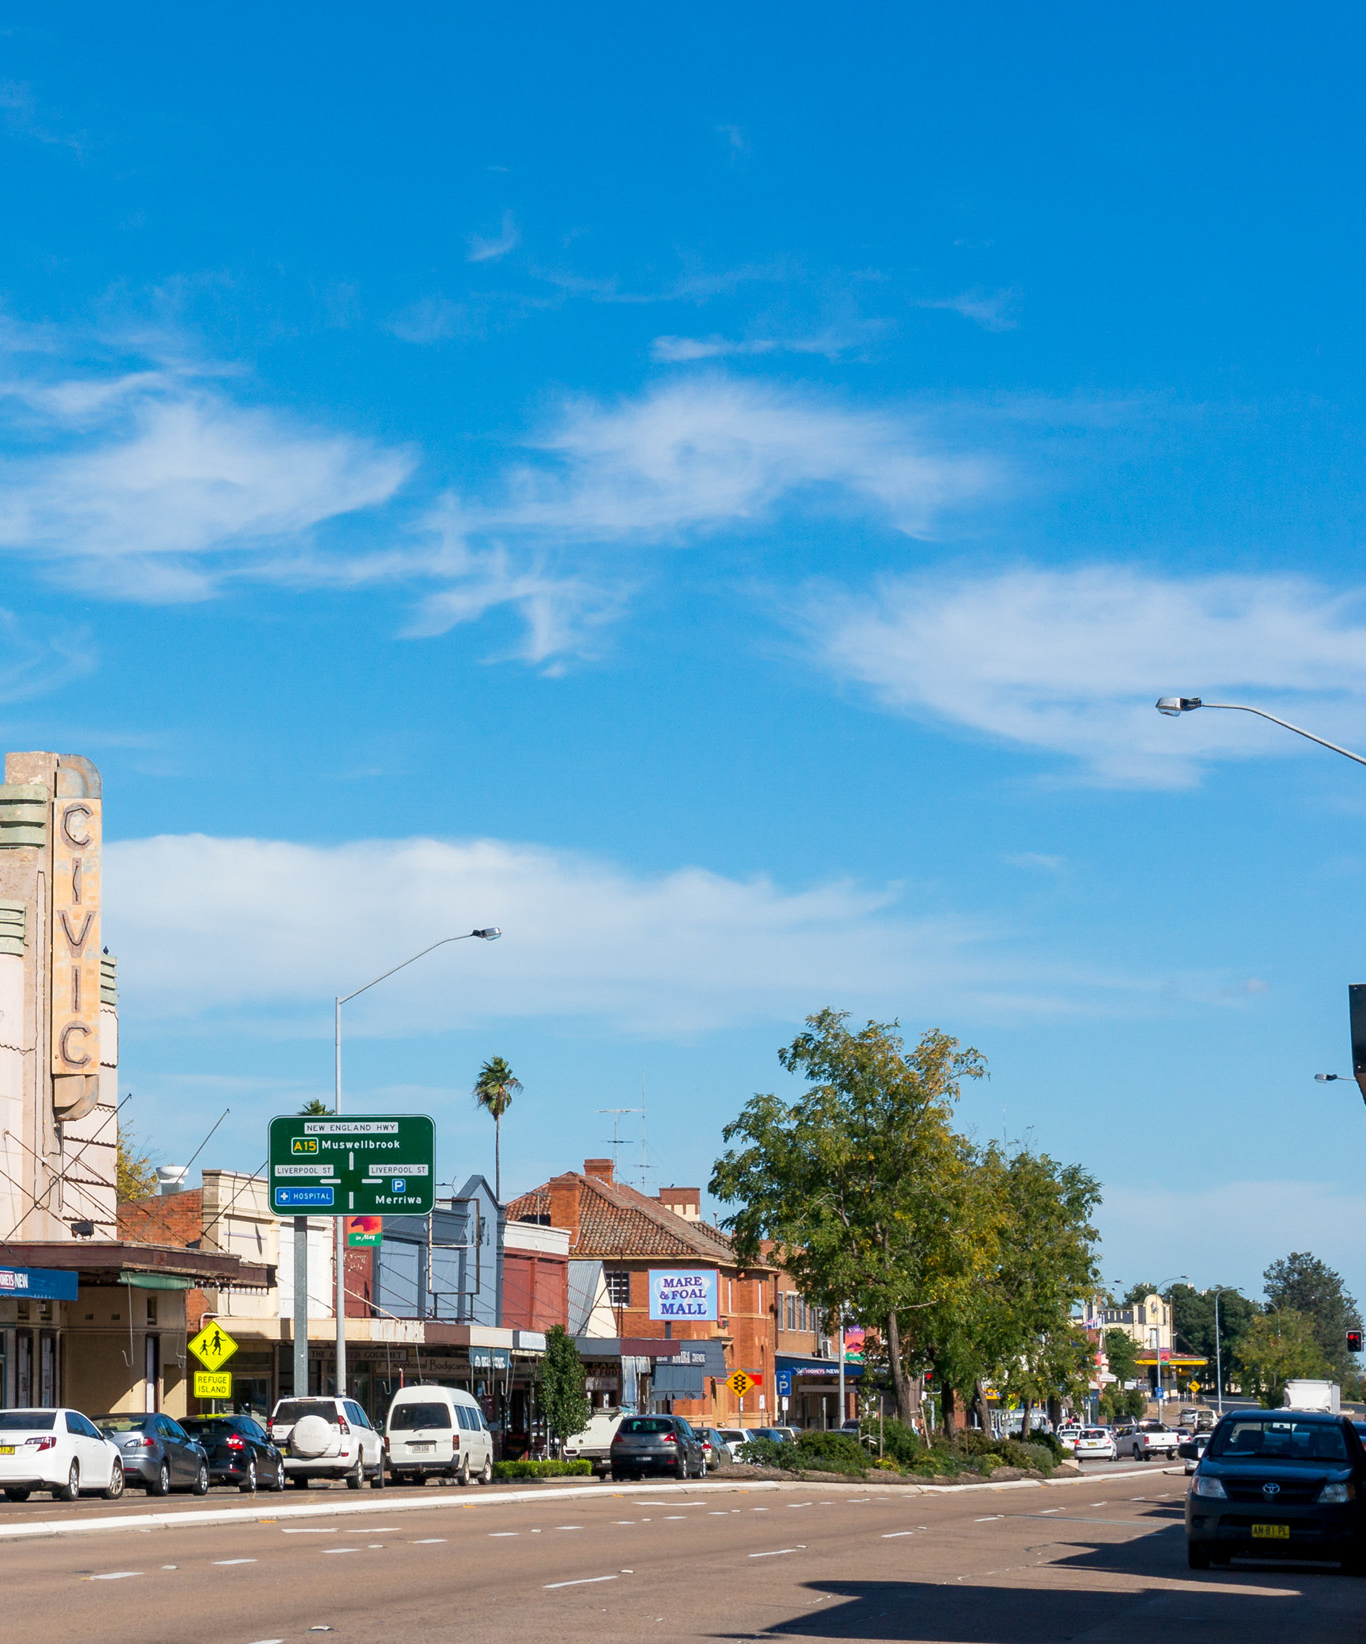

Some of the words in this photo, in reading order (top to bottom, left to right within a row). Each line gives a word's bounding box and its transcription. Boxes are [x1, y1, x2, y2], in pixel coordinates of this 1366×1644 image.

[57, 802, 97, 1069] CIVIC
[306, 1124, 326, 1132] NEW
[293, 1141, 317, 1151] A15
[321, 1139, 400, 1149] Muswellbrook
[322, 1166, 331, 1174] ST
[371, 1166, 413, 1174] LIVERPOOL
[394, 1180, 404, 1190] P
[293, 1192, 330, 1200] HOSPITAL
[375, 1195, 422, 1204] Merriwa
[14, 1273, 29, 1289] NEW
[663, 1276, 702, 1288] MARE
[659, 1290, 669, 1300] &
[671, 1289, 707, 1300] FOAL
[660, 1303, 707, 1315] MALL
[365, 1351, 402, 1359] GOURMET
[197, 1376, 227, 1384] REFUGE
[198, 1385, 226, 1393] ISLAND
